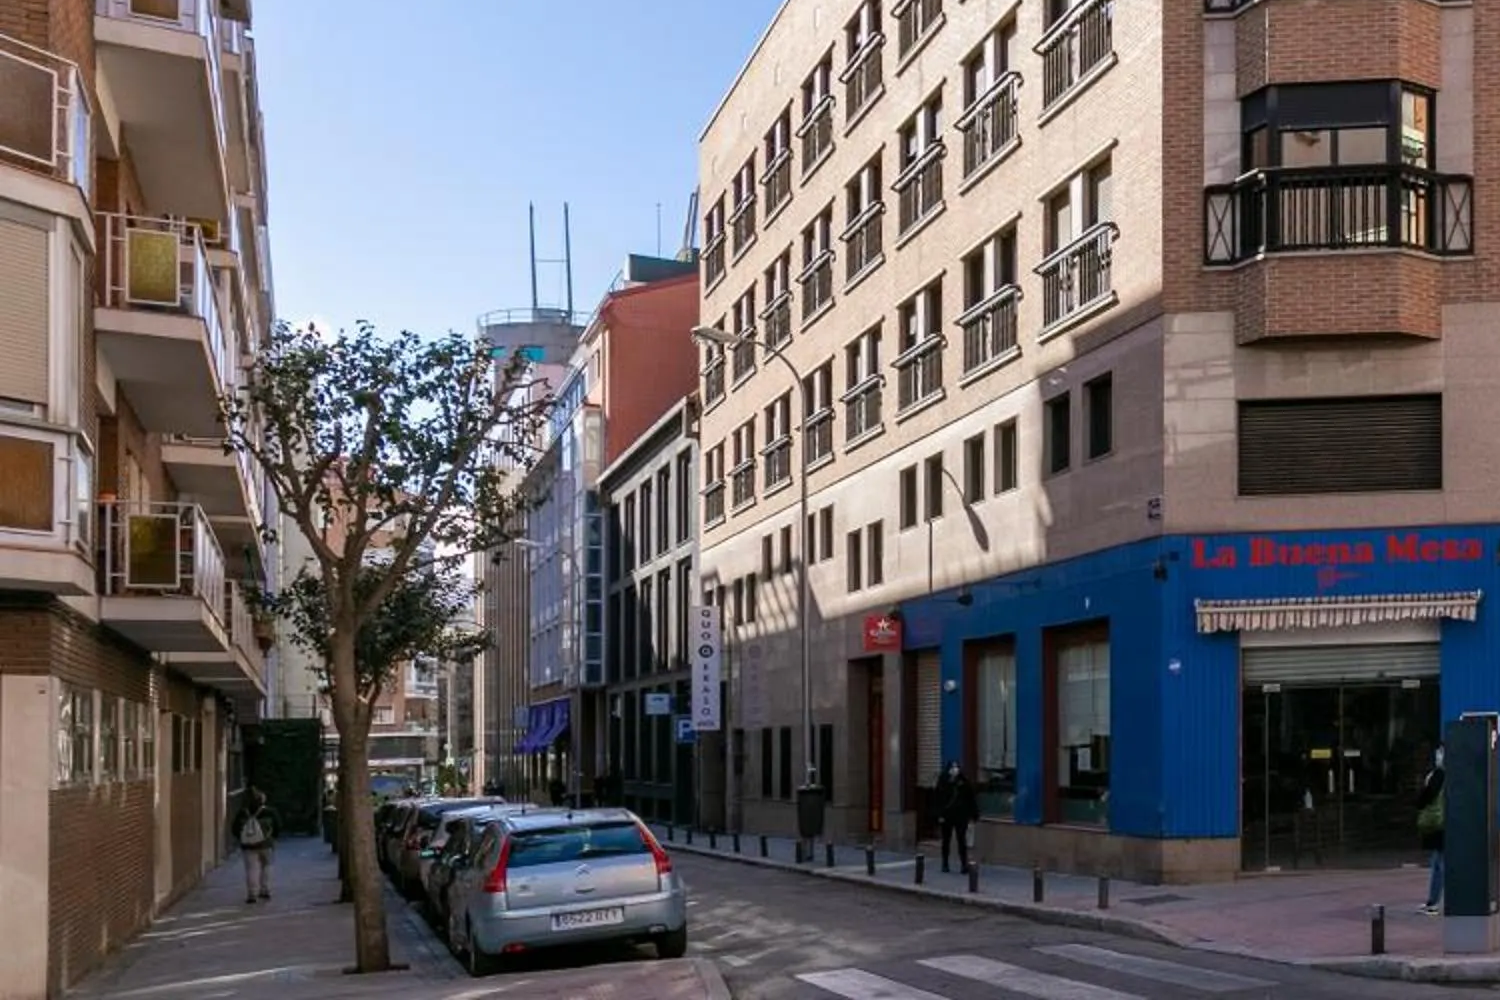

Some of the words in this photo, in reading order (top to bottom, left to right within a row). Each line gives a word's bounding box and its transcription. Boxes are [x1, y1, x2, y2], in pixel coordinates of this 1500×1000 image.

[1193, 538, 1236, 568] La
[1250, 537, 1374, 567] Buena
[1386, 533, 1482, 561] Mesa
[701, 609, 712, 640] QUO
[679, 719, 693, 739] P
